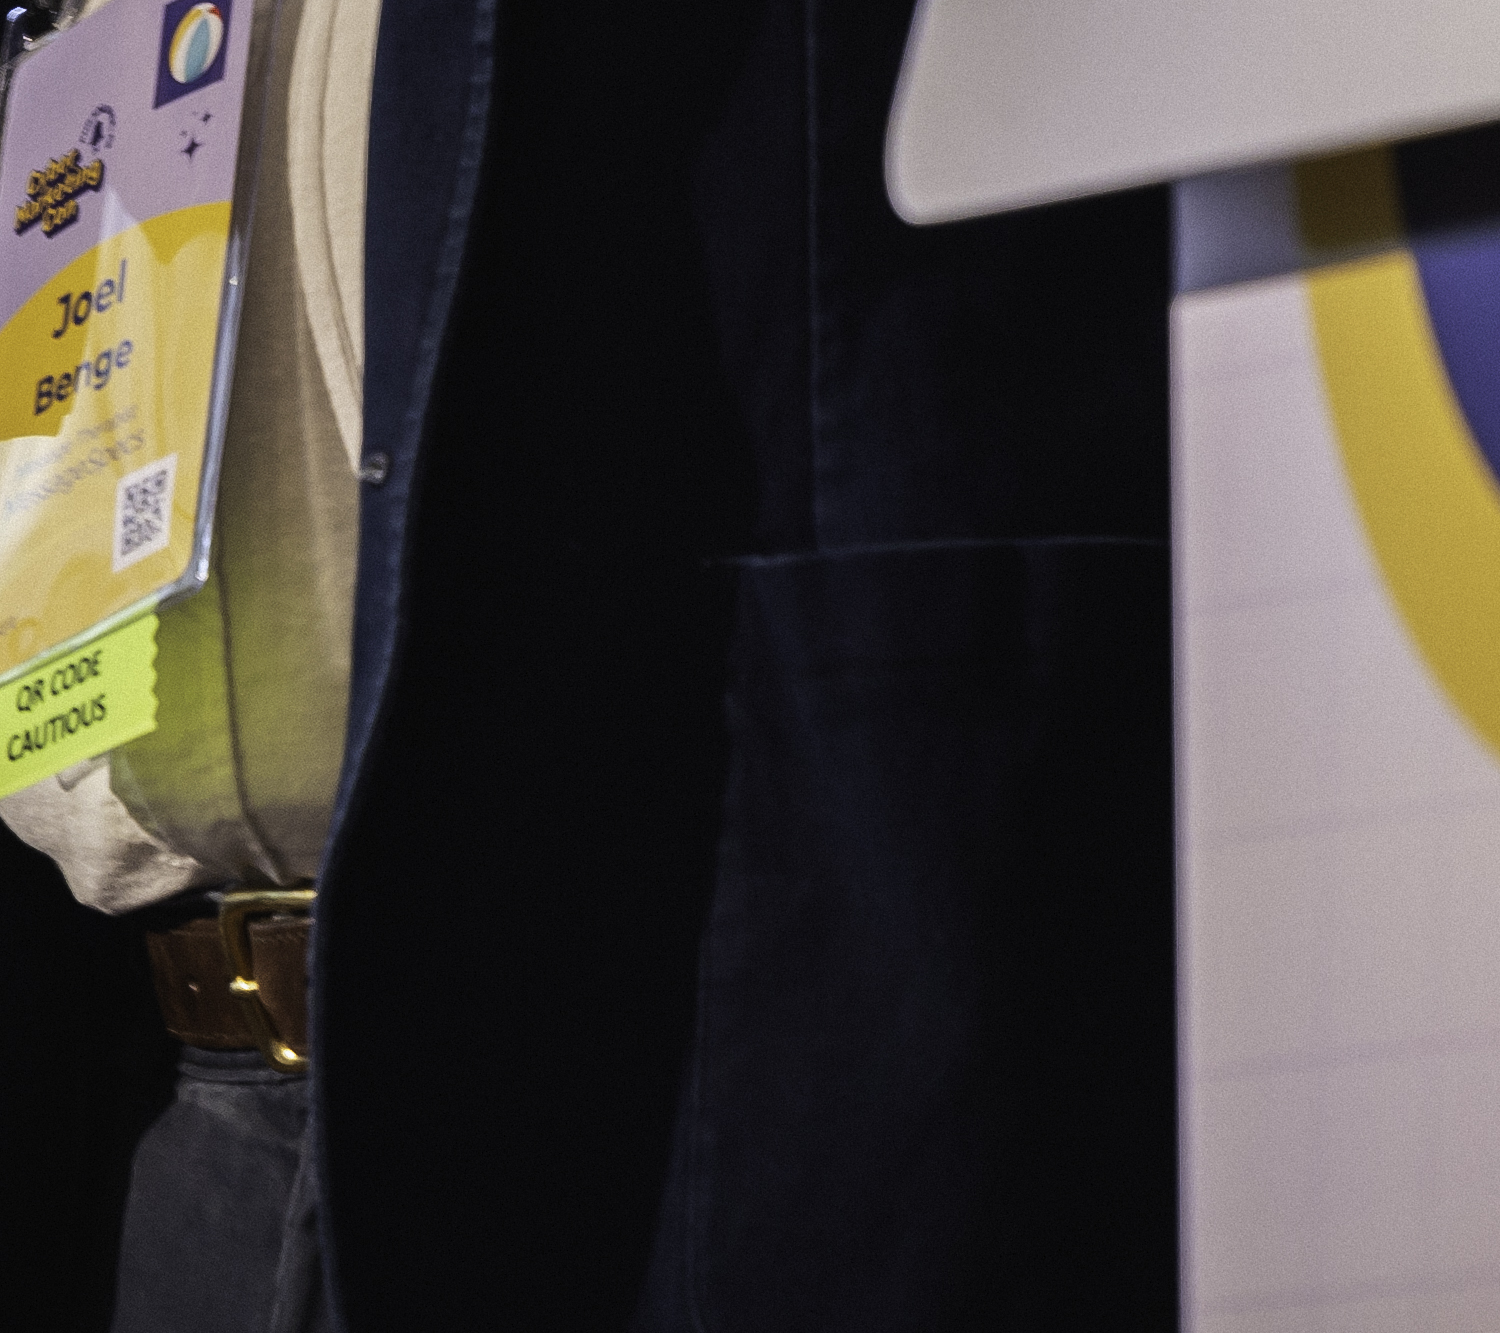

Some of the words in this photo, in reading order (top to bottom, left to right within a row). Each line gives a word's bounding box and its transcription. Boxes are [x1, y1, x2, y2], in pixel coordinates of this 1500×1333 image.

[52, 258, 127, 339] Joel
[34, 339, 134, 415] Benge
[16, 679, 44, 712] QR
[50, 650, 103, 696] CODE
[7, 694, 106, 761] CAUTIOUS
